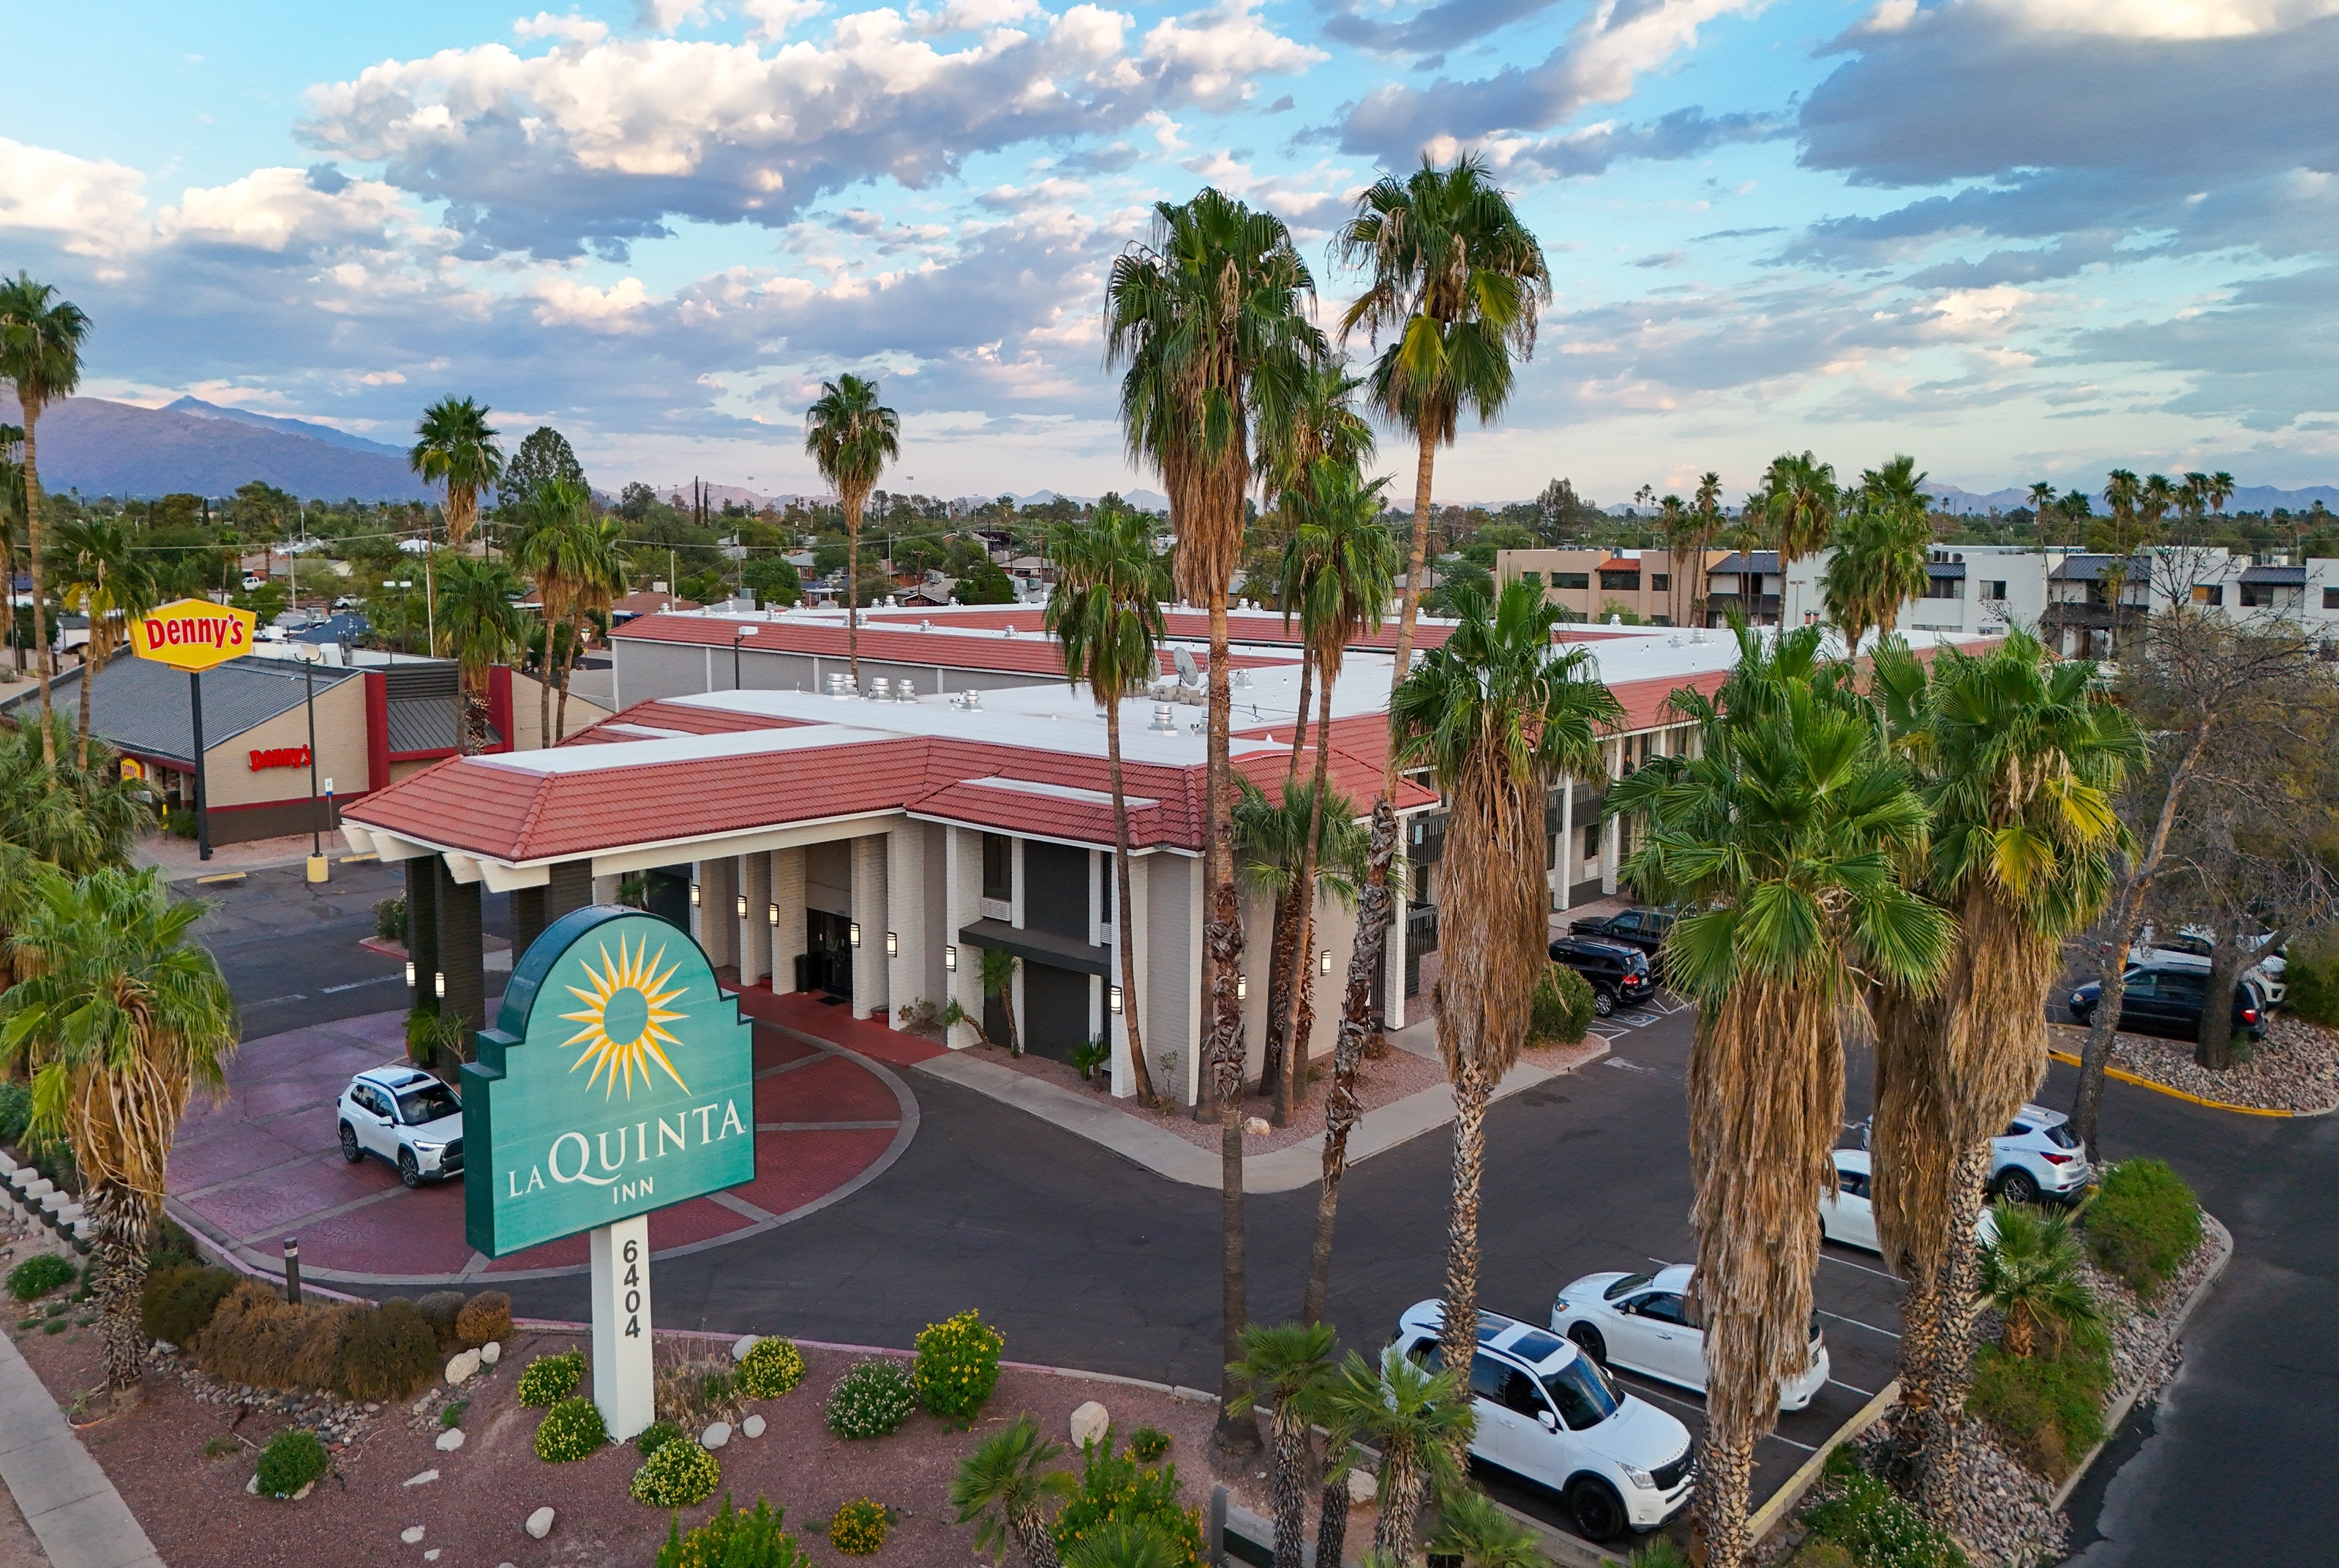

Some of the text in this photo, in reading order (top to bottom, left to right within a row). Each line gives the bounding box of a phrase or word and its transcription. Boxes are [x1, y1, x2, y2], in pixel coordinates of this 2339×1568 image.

[144, 613, 244, 651] Denny's
[249, 744, 311, 772] Denny's
[508, 1098, 747, 1198] LA QUINTA
[613, 1176, 653, 1204] INN
[623, 1239, 641, 1338] 6404
